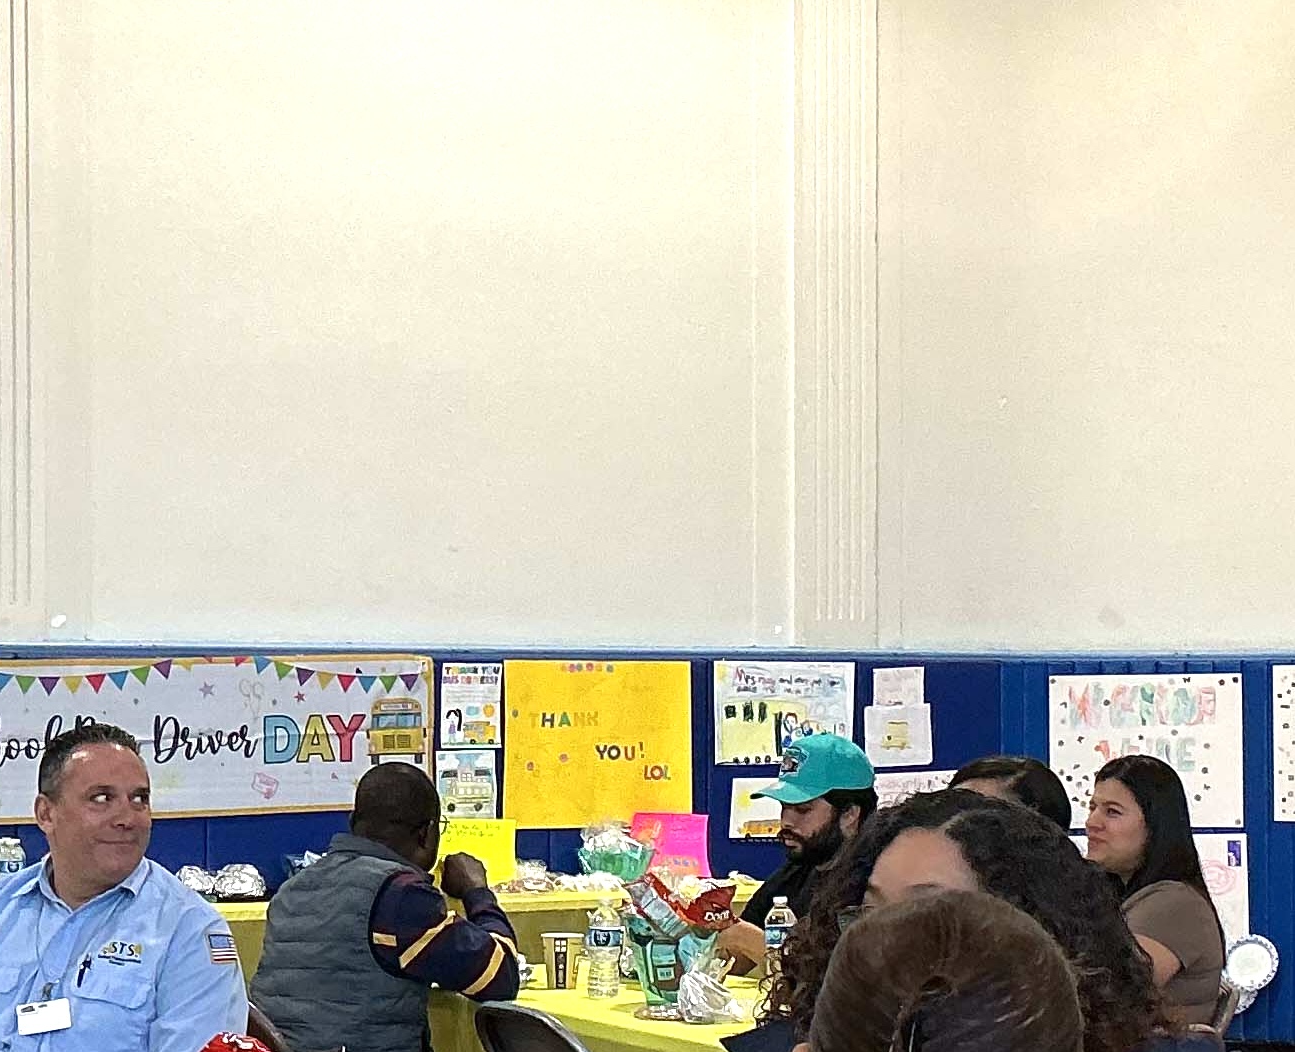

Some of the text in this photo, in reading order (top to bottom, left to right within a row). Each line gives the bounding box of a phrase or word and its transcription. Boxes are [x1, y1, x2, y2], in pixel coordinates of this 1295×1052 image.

[529, 710, 599, 729] THANK
[154, 714, 258, 765] Driver
[262, 714, 367, 765] DAY
[595, 741, 646, 761] YOU!
